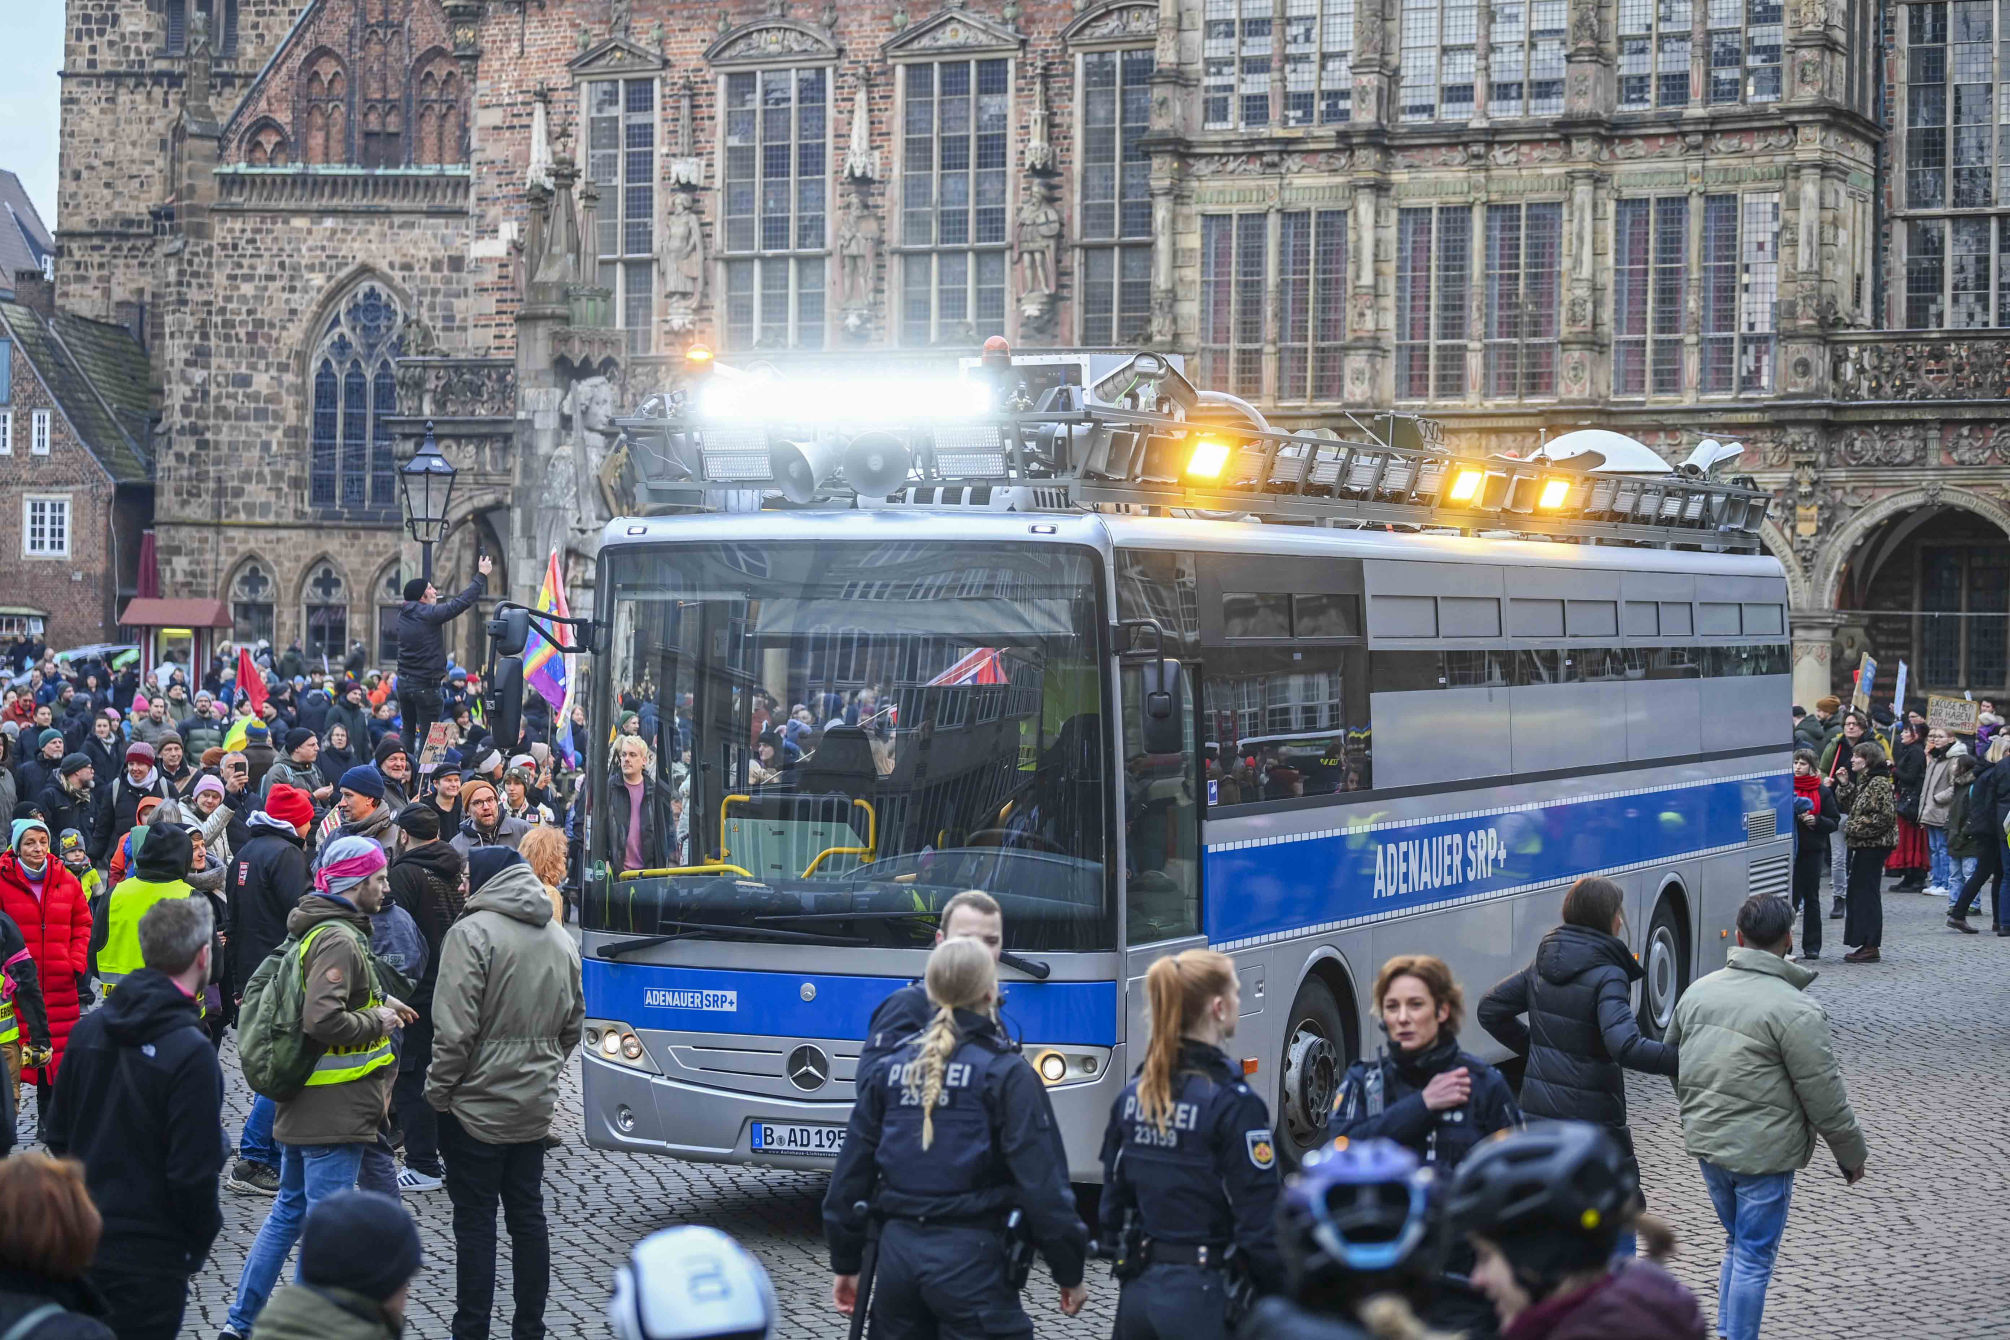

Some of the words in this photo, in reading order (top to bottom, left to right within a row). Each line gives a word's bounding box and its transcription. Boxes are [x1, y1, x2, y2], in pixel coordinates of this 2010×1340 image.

[1373, 833, 1463, 899] ADENAUER
[1466, 827, 1507, 882] SRP+
[645, 989, 702, 1008] ADENAUER
[704, 993, 735, 1009] SRP+
[763, 1126, 775, 1146] B
[787, 1127, 811, 1148] AD
